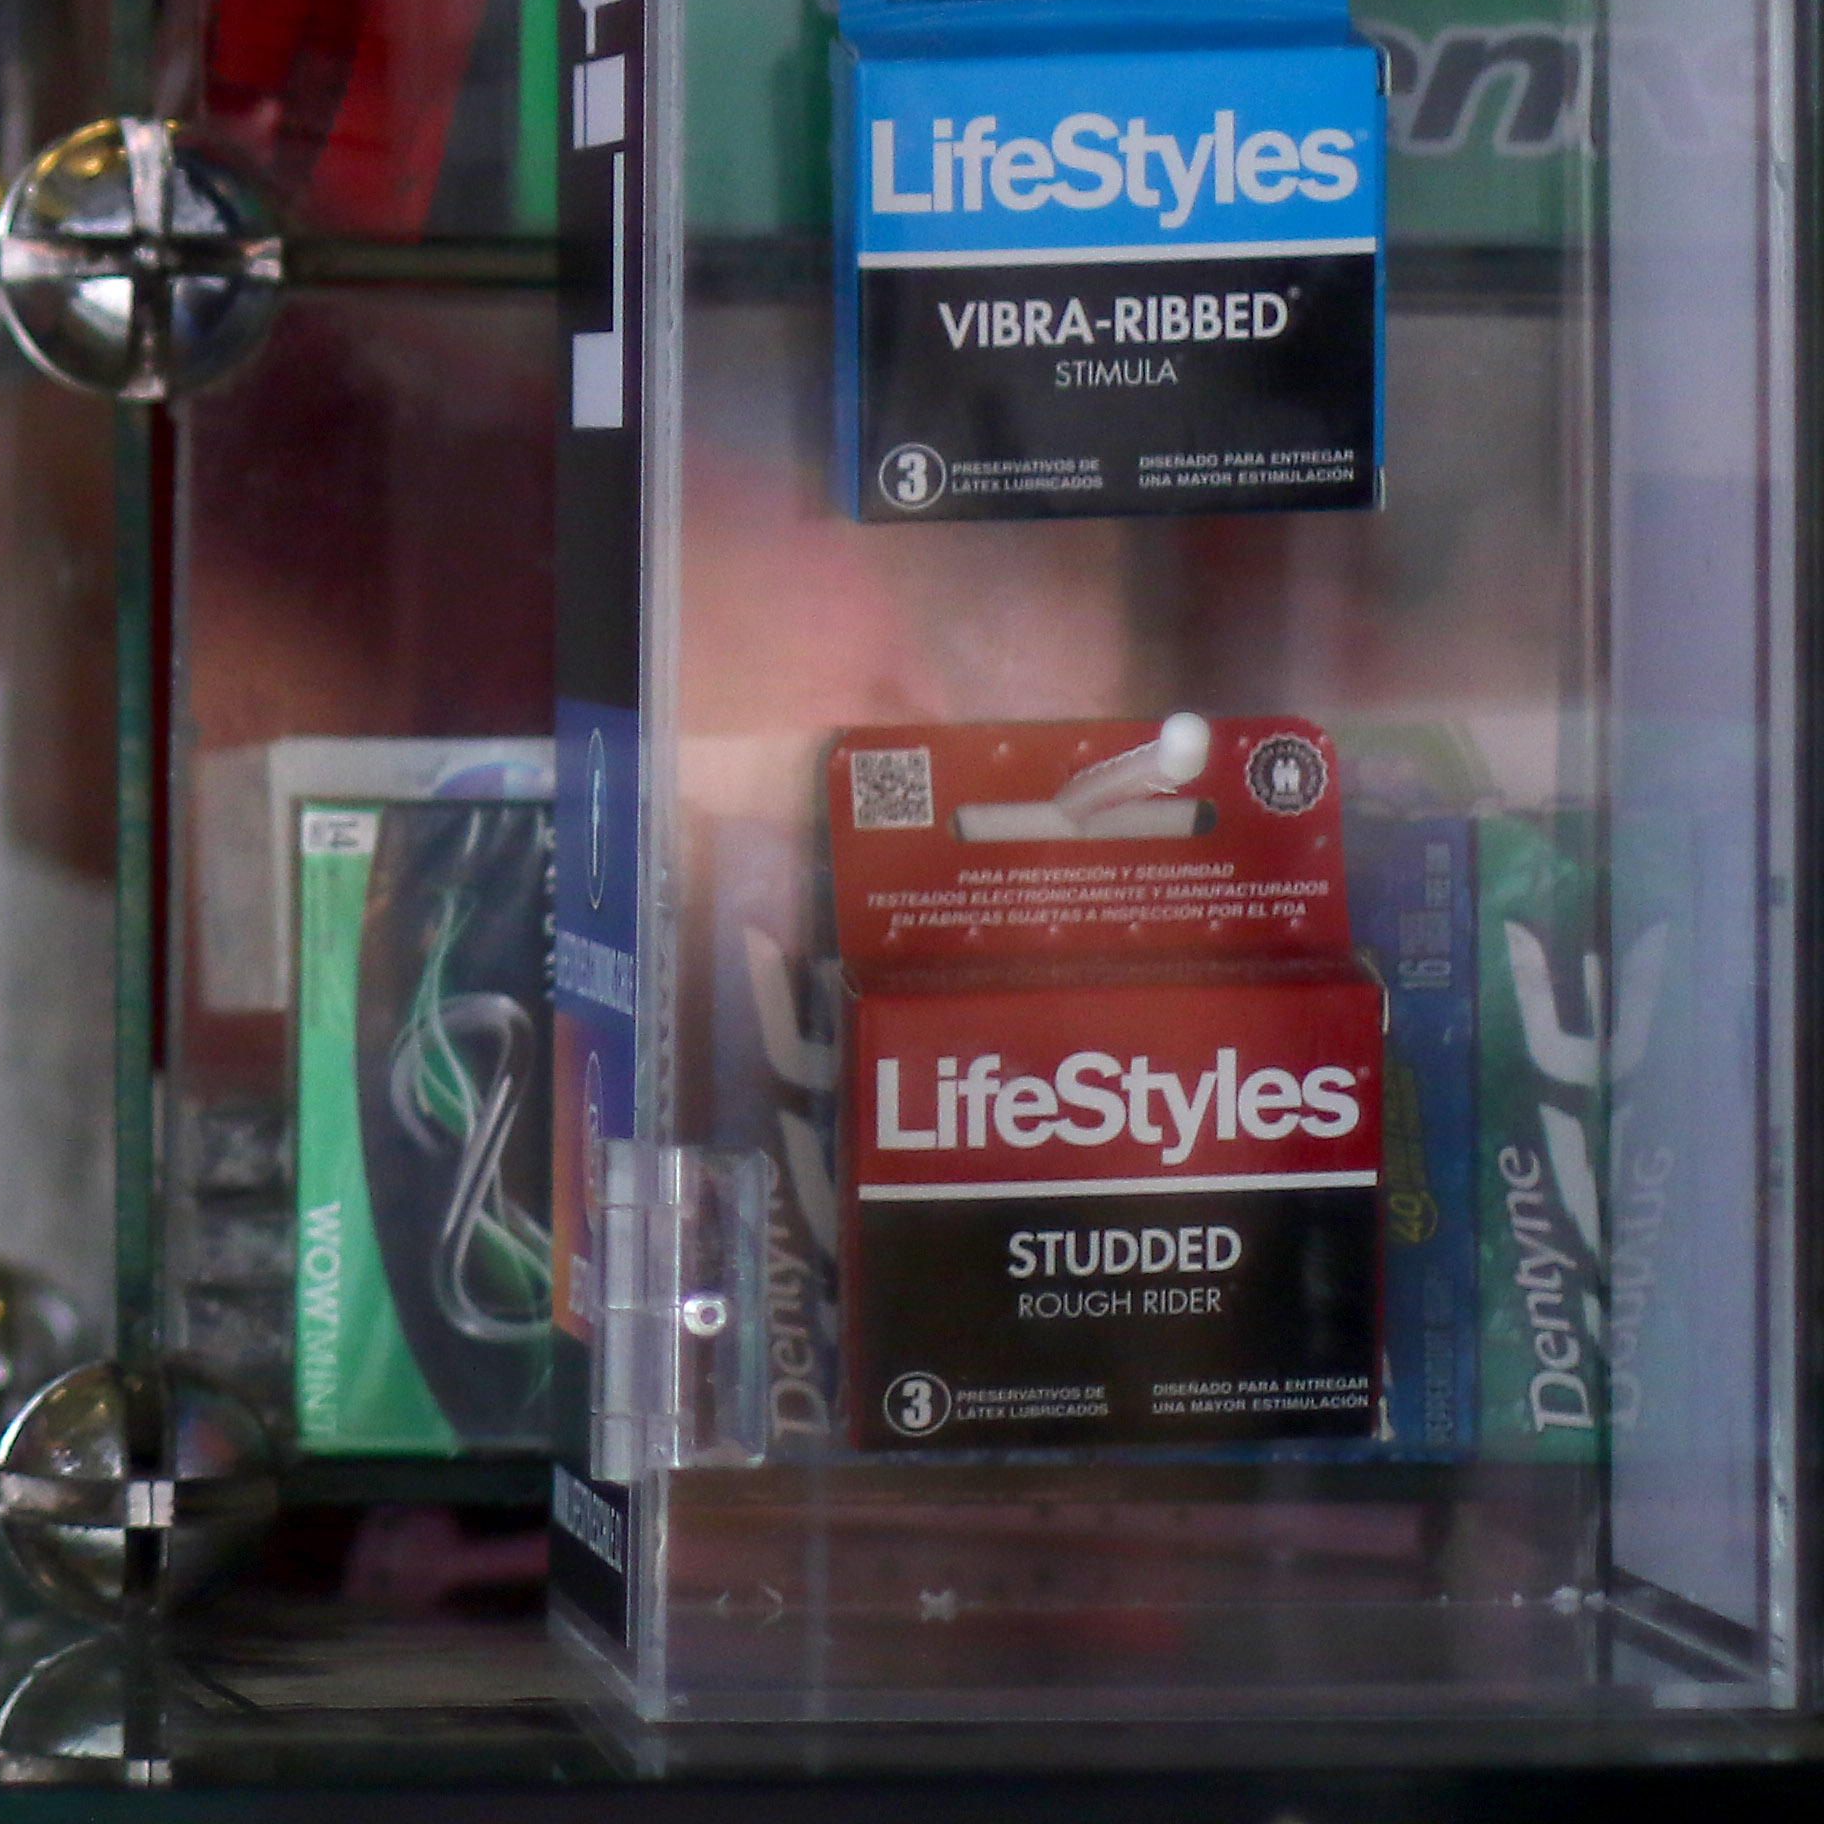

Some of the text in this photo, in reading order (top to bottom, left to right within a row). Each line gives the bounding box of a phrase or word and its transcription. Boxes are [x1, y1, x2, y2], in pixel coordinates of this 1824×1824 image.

[870, 109, 1359, 230] LifeStyles
[938, 292, 1290, 351] VIBRA-RIBBED
[1054, 356, 1179, 388] STIMULA
[896, 451, 929, 503] 3
[875, 1047, 1362, 1165] LifeStyles
[1007, 1225, 1243, 1279] STUDDED
[1017, 1286, 1224, 1320] ROUGH RIDER
[1498, 1145, 1597, 1436] Dentyne
[901, 1380, 934, 1430] 3
